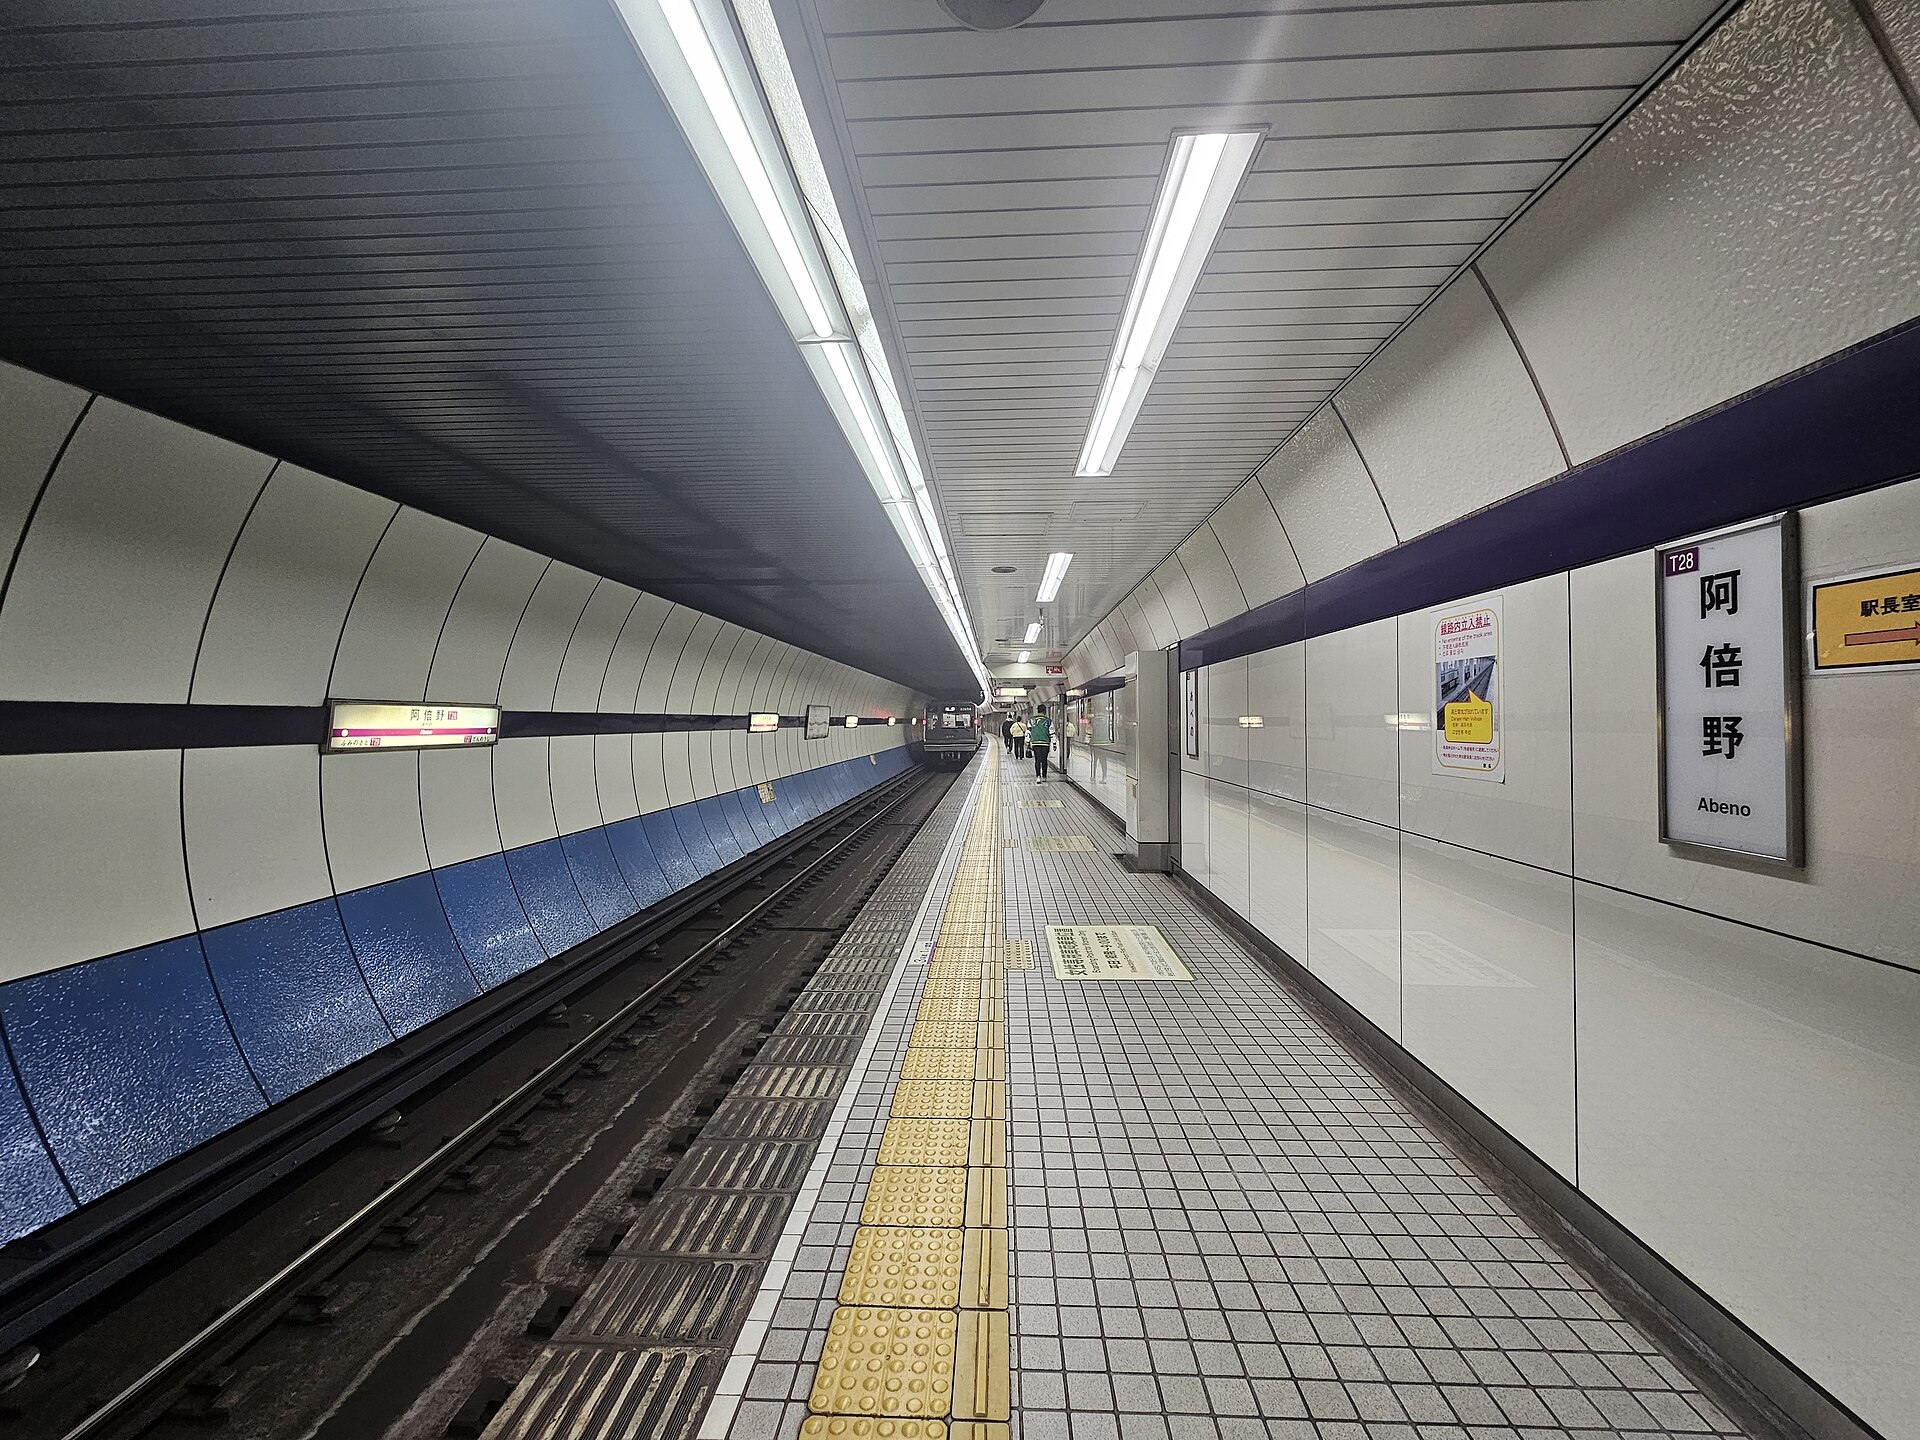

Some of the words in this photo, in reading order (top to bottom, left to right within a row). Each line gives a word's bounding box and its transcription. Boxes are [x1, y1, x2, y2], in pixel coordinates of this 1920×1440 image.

[1669, 552, 1694, 572] T28
[1860, 594, 1920, 617] 駅長室
[1700, 569, 1744, 759] 阿倍野
[410, 708, 445, 721] 阿倍野
[1697, 797, 1751, 817] Abeno
